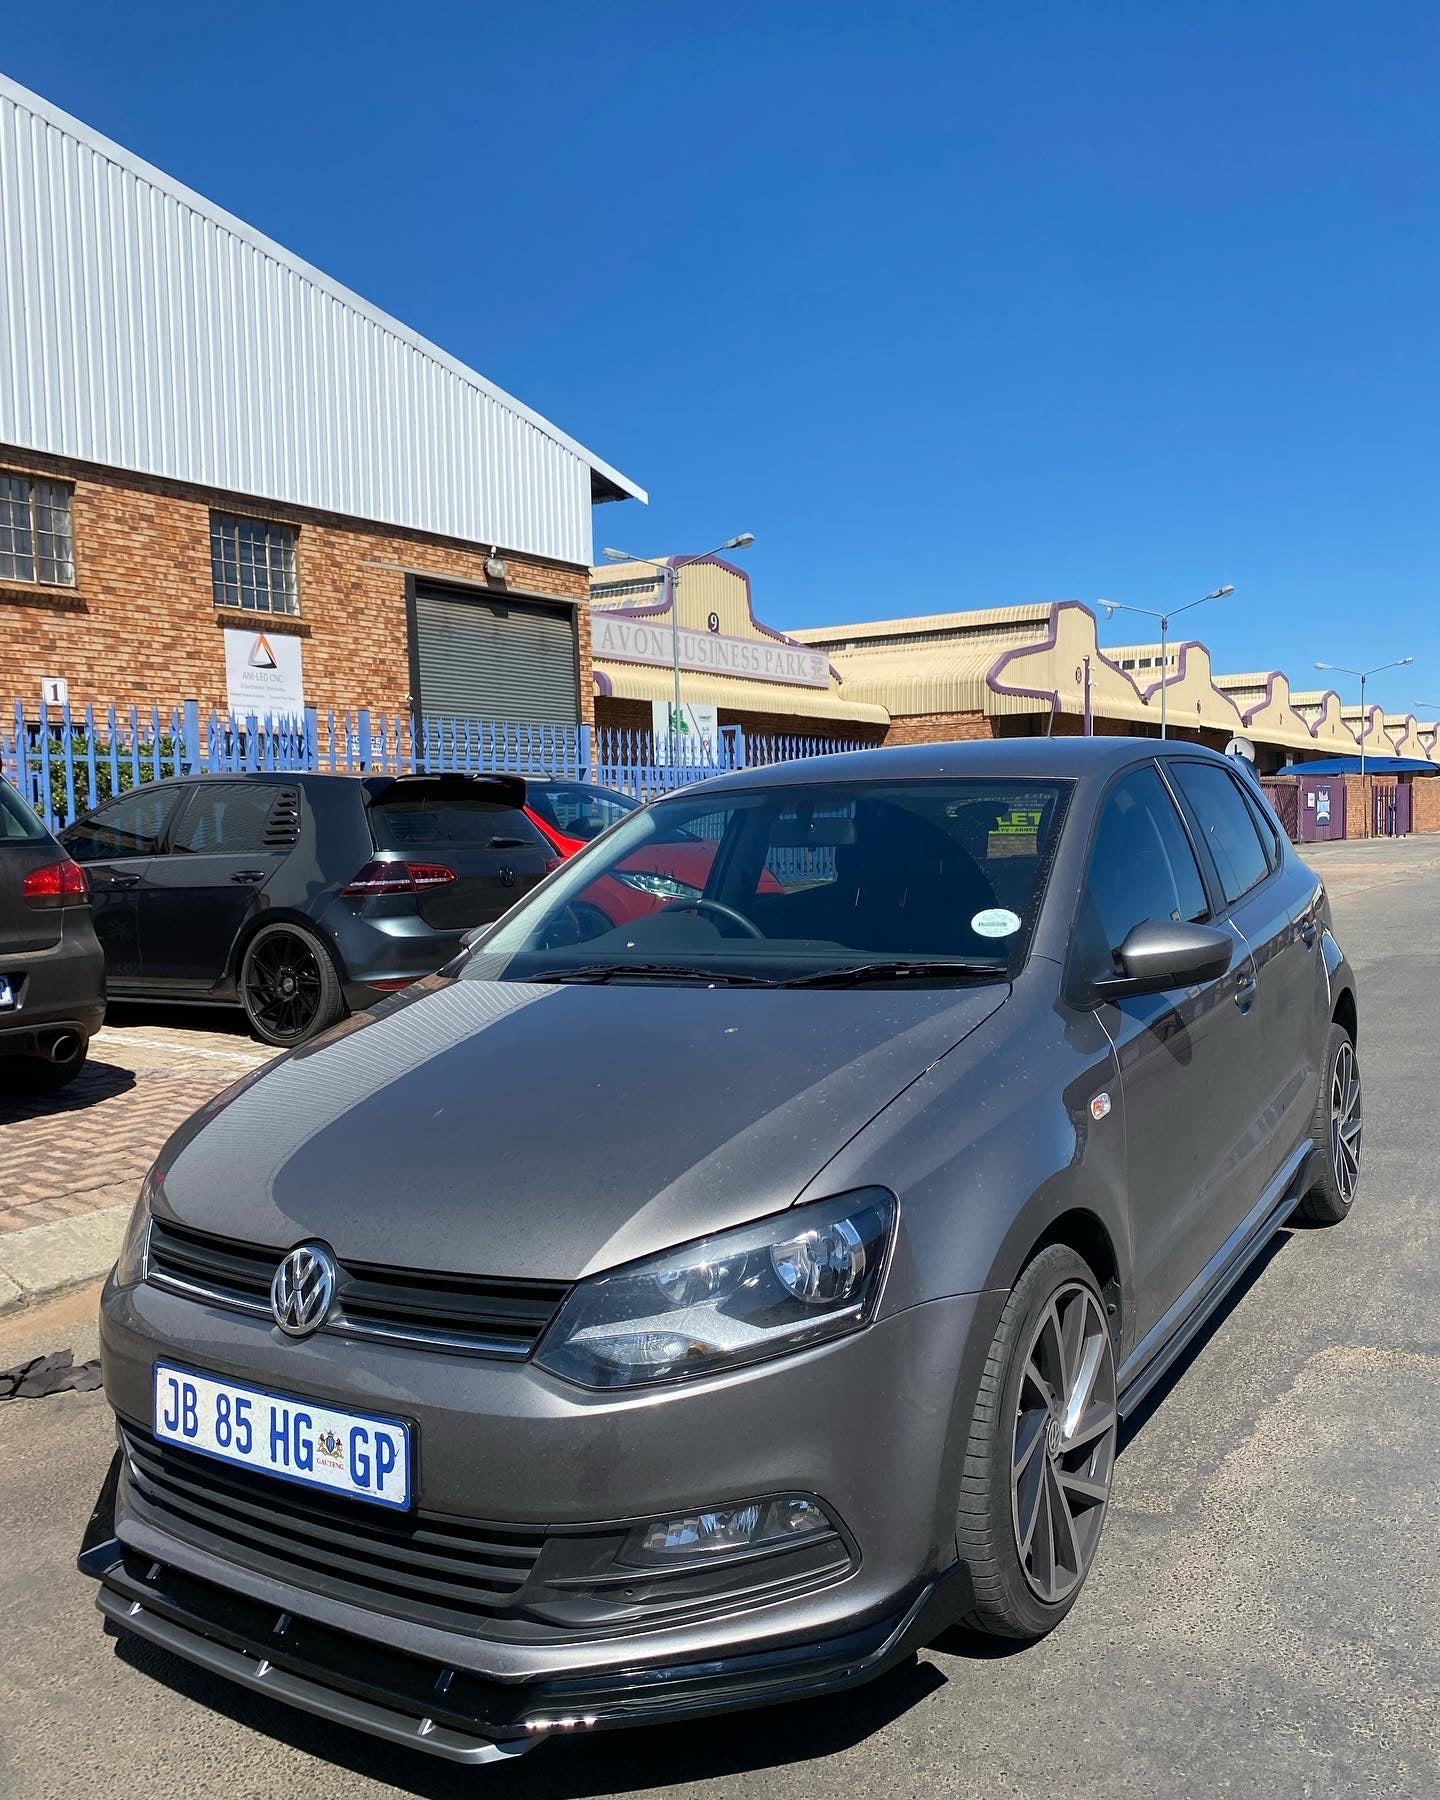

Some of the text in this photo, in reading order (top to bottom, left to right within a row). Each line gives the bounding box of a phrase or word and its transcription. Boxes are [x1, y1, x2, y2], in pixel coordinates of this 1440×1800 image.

[710, 615, 718, 630] 9
[601, 623, 664, 657] AVON
[765, 650, 807, 677] PARK
[51, 683, 60, 702] 1
[164, 1378, 396, 1491] JB 85 HG GP
[316, 1458, 344, 1470] GAUTENG
